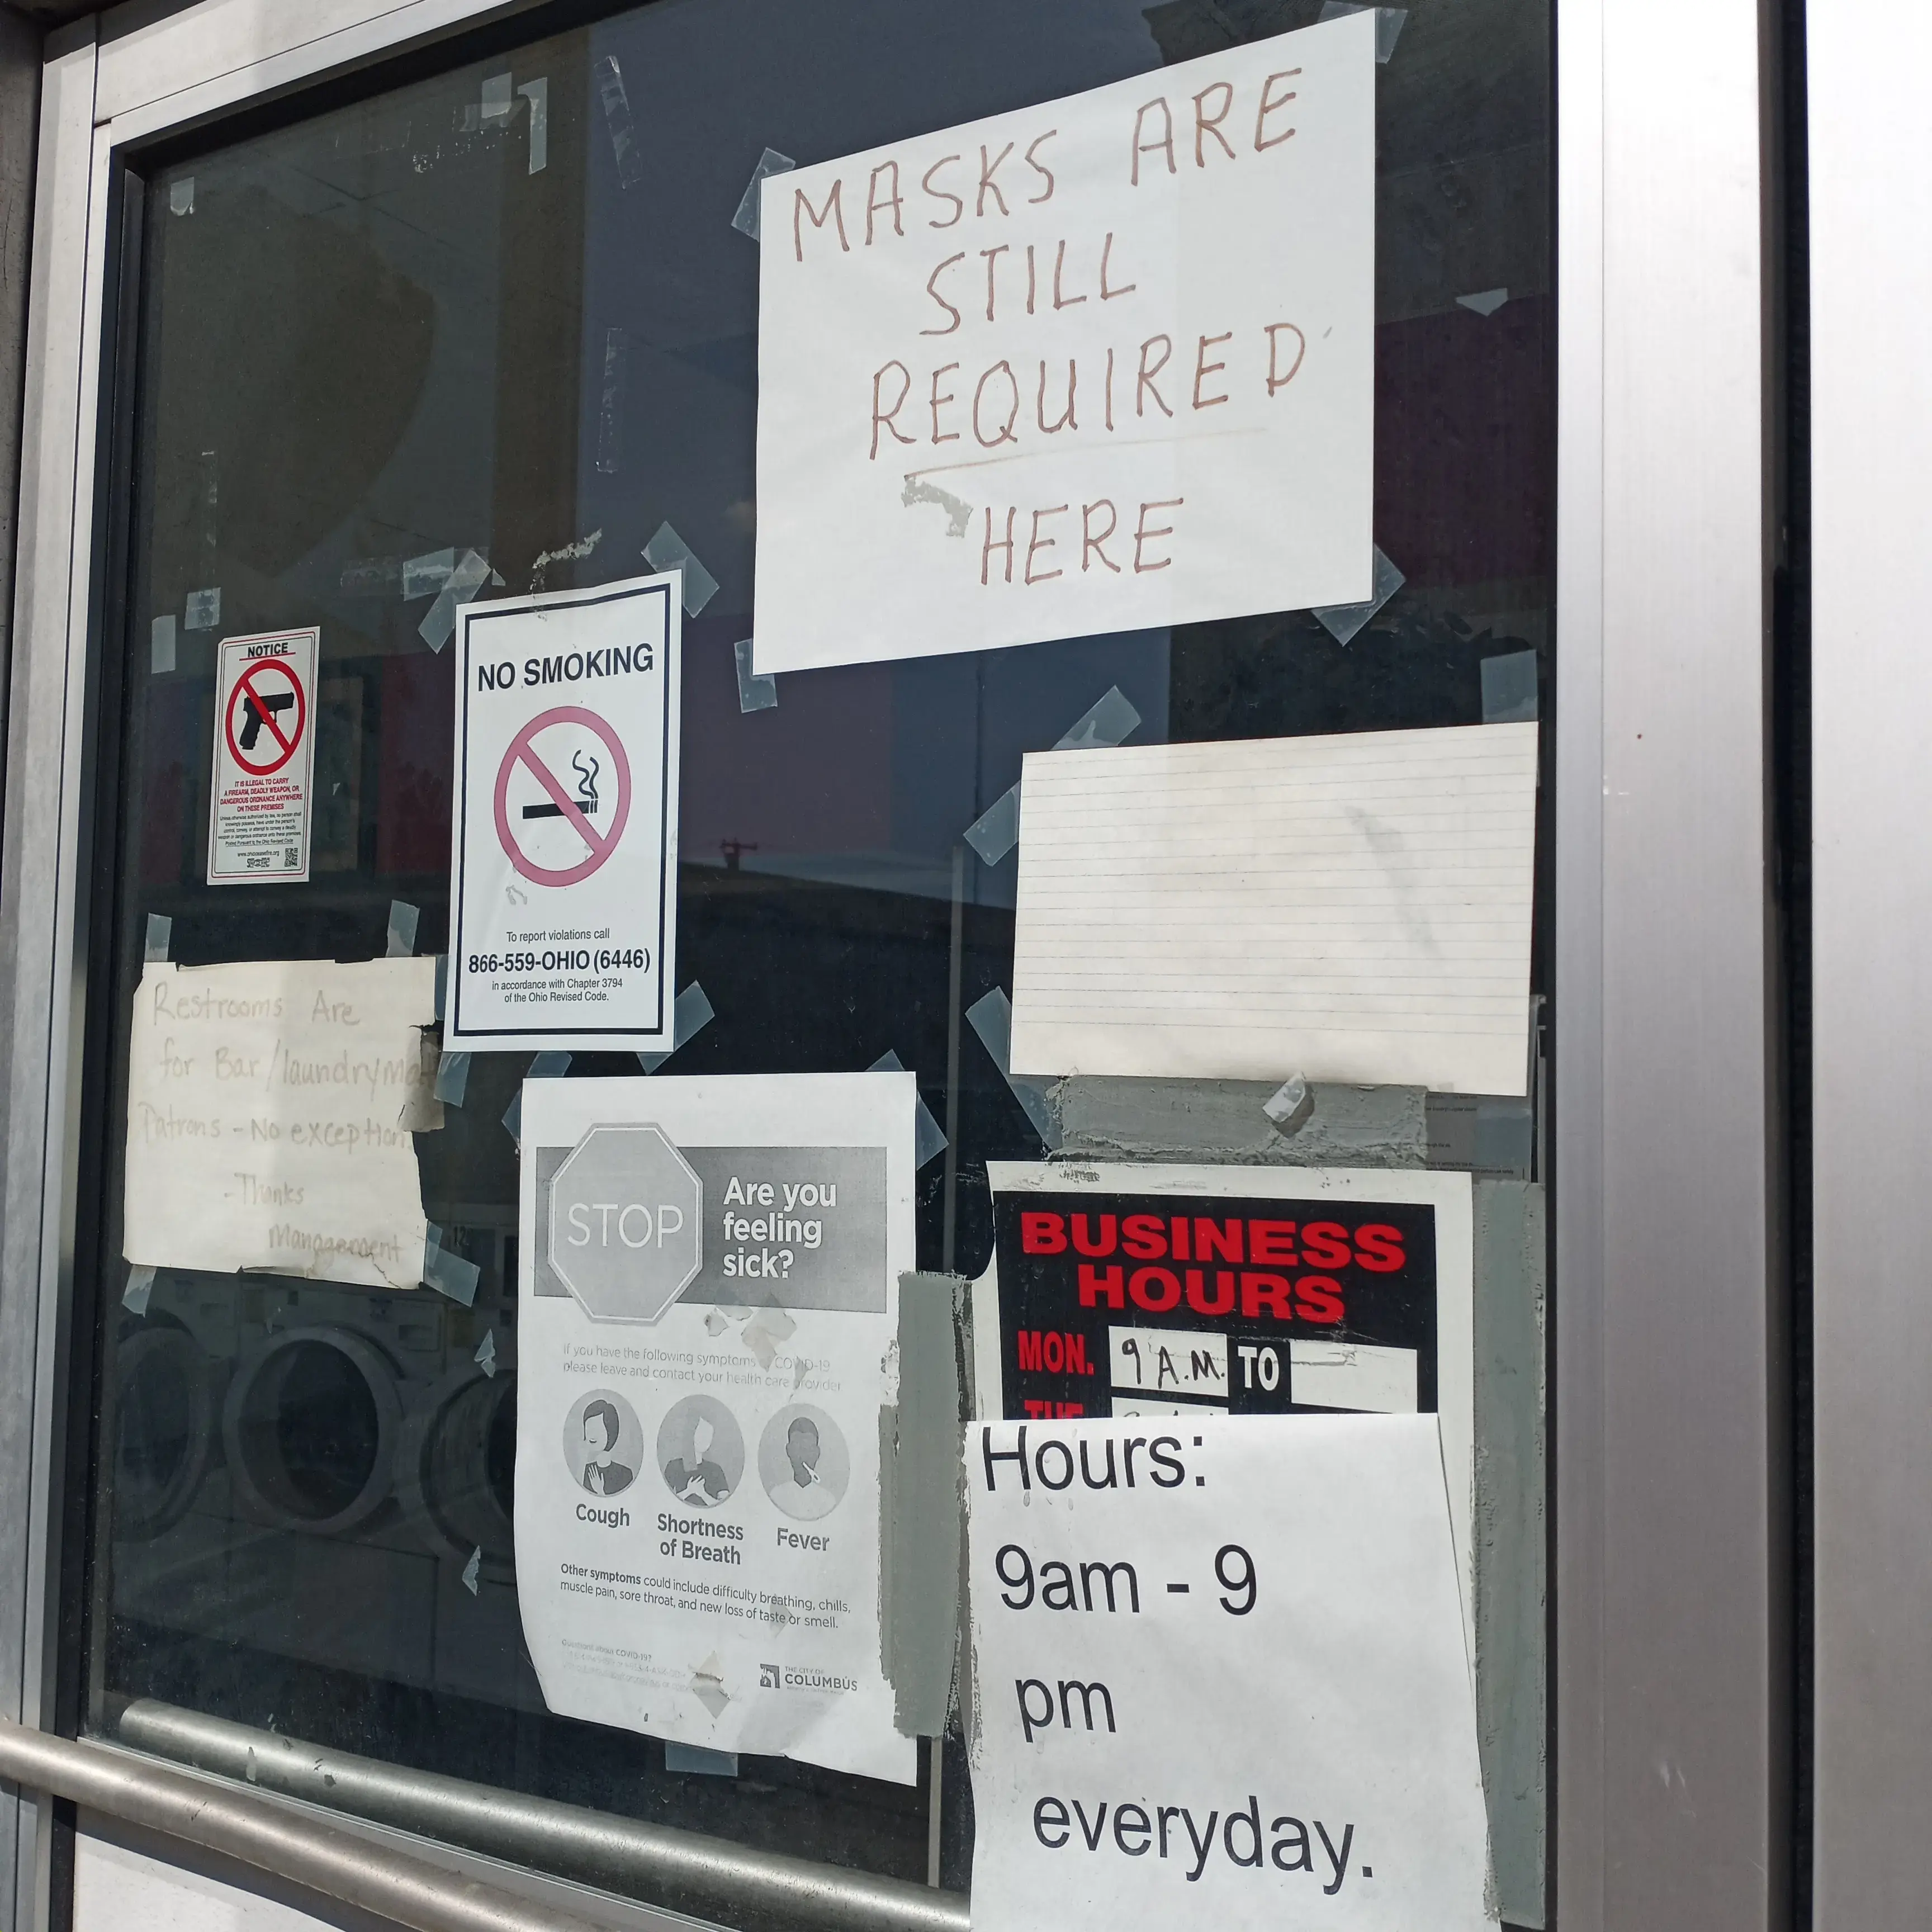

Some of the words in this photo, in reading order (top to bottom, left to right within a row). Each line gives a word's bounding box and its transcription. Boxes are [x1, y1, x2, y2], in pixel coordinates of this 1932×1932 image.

[794, 128, 1058, 262] MASKS
[1130, 67, 1303, 187] ARE
[919, 232, 1137, 335] STILL
[869, 322, 1307, 461] REQUIRED
[981, 498, 1185, 585] HERE
[247, 642, 288, 658] NOTICE
[478, 662, 515, 692] NO
[524, 643, 654, 686] SMOKING
[506, 931, 518, 943] To
[519, 930, 546, 944] report
[548, 929, 591, 941] violations
[594, 927, 610, 939] call
[468, 950, 590, 973] 866-559-OHIO
[594, 948, 651, 974] (6446)
[154, 981, 283, 1026] Restrooms
[311, 989, 361, 1025] Are
[492, 980, 499, 990] in
[501, 979, 546, 989] accordance
[548, 978, 565, 989] with
[567, 978, 600, 991] Chapter
[602, 978, 623, 988] 3794
[504, 992, 513, 1003] of
[514, 992, 526, 1002] the
[528, 991, 548, 1002] Ohio
[550, 991, 583, 1001] Revised
[584, 990, 609, 1001] Code.
[160, 1036, 195, 1080] for
[138, 1100, 221, 1143] Patrons
[251, 1117, 280, 1142] No
[722, 1176, 775, 1207] Are
[782, 1181, 837, 1212] you
[566, 1202, 684, 1249] STOP
[722, 1211, 822, 1249] feeling
[1020, 1210, 1406, 1272] BUSINESS
[722, 1249, 795, 1280] sick?
[1077, 1264, 1345, 1324] HOURS
[564, 1343, 570, 1355] If
[574, 1346, 593, 1357] you
[596, 1344, 621, 1358] have
[623, 1347, 640, 1359] the
[643, 1348, 694, 1365] following
[697, 1353, 756, 1367] symptoms
[564, 1360, 597, 1374] please
[600, 1362, 627, 1376] leave
[630, 1365, 650, 1378] and
[653, 1368, 695, 1381] contact
[698, 1371, 723, 1384] your
[726, 1371, 761, 1386] health
[765, 1376, 789, 1388] care
[1017, 1330, 1095, 1375] MON.
[1121, 1338, 1142, 1385] 9
[1157, 1348, 1226, 1390] A.M.
[1238, 1345, 1280, 1391] TO
[982, 1425, 1206, 1491] Hours:
[576, 1503, 630, 1528] Cough
[657, 1513, 744, 1541] Shortness
[660, 1539, 677, 1557] of
[681, 1540, 741, 1565] Breath
[777, 1527, 830, 1551] Fever
[561, 1563, 588, 1577] Other
[590, 1568, 641, 1585] symptoms
[643, 1576, 671, 1589] could
[673, 1579, 710, 1594] include
[712, 1584, 757, 1603] difficulty
[760, 1591, 816, 1611] breathing,
[818, 1599, 851, 1614] chills,
[995, 1545, 1140, 1614] 9am
[1166, 1583, 1190, 1594] -
[1214, 1545, 1258, 1616] 9
[560, 1581, 593, 1594] muscle
[595, 1586, 617, 1600] pain,
[619, 1590, 641, 1602] sore
[643, 1592, 676, 1608] throat,
[678, 1598, 697, 1610] and
[700, 1602, 722, 1614] new
[725, 1602, 744, 1617] loss
[746, 1608, 757, 1620] of
[760, 1609, 785, 1623] taste
[789, 1616, 801, 1625] or
[804, 1616, 839, 1628] smell.
[615, 1649, 652, 1662] COVID-19?
[784, 1673, 858, 1692] COLUMBUS
[1015, 1679, 1117, 1743] pm
[1033, 1794, 1374, 1896] everyday.
